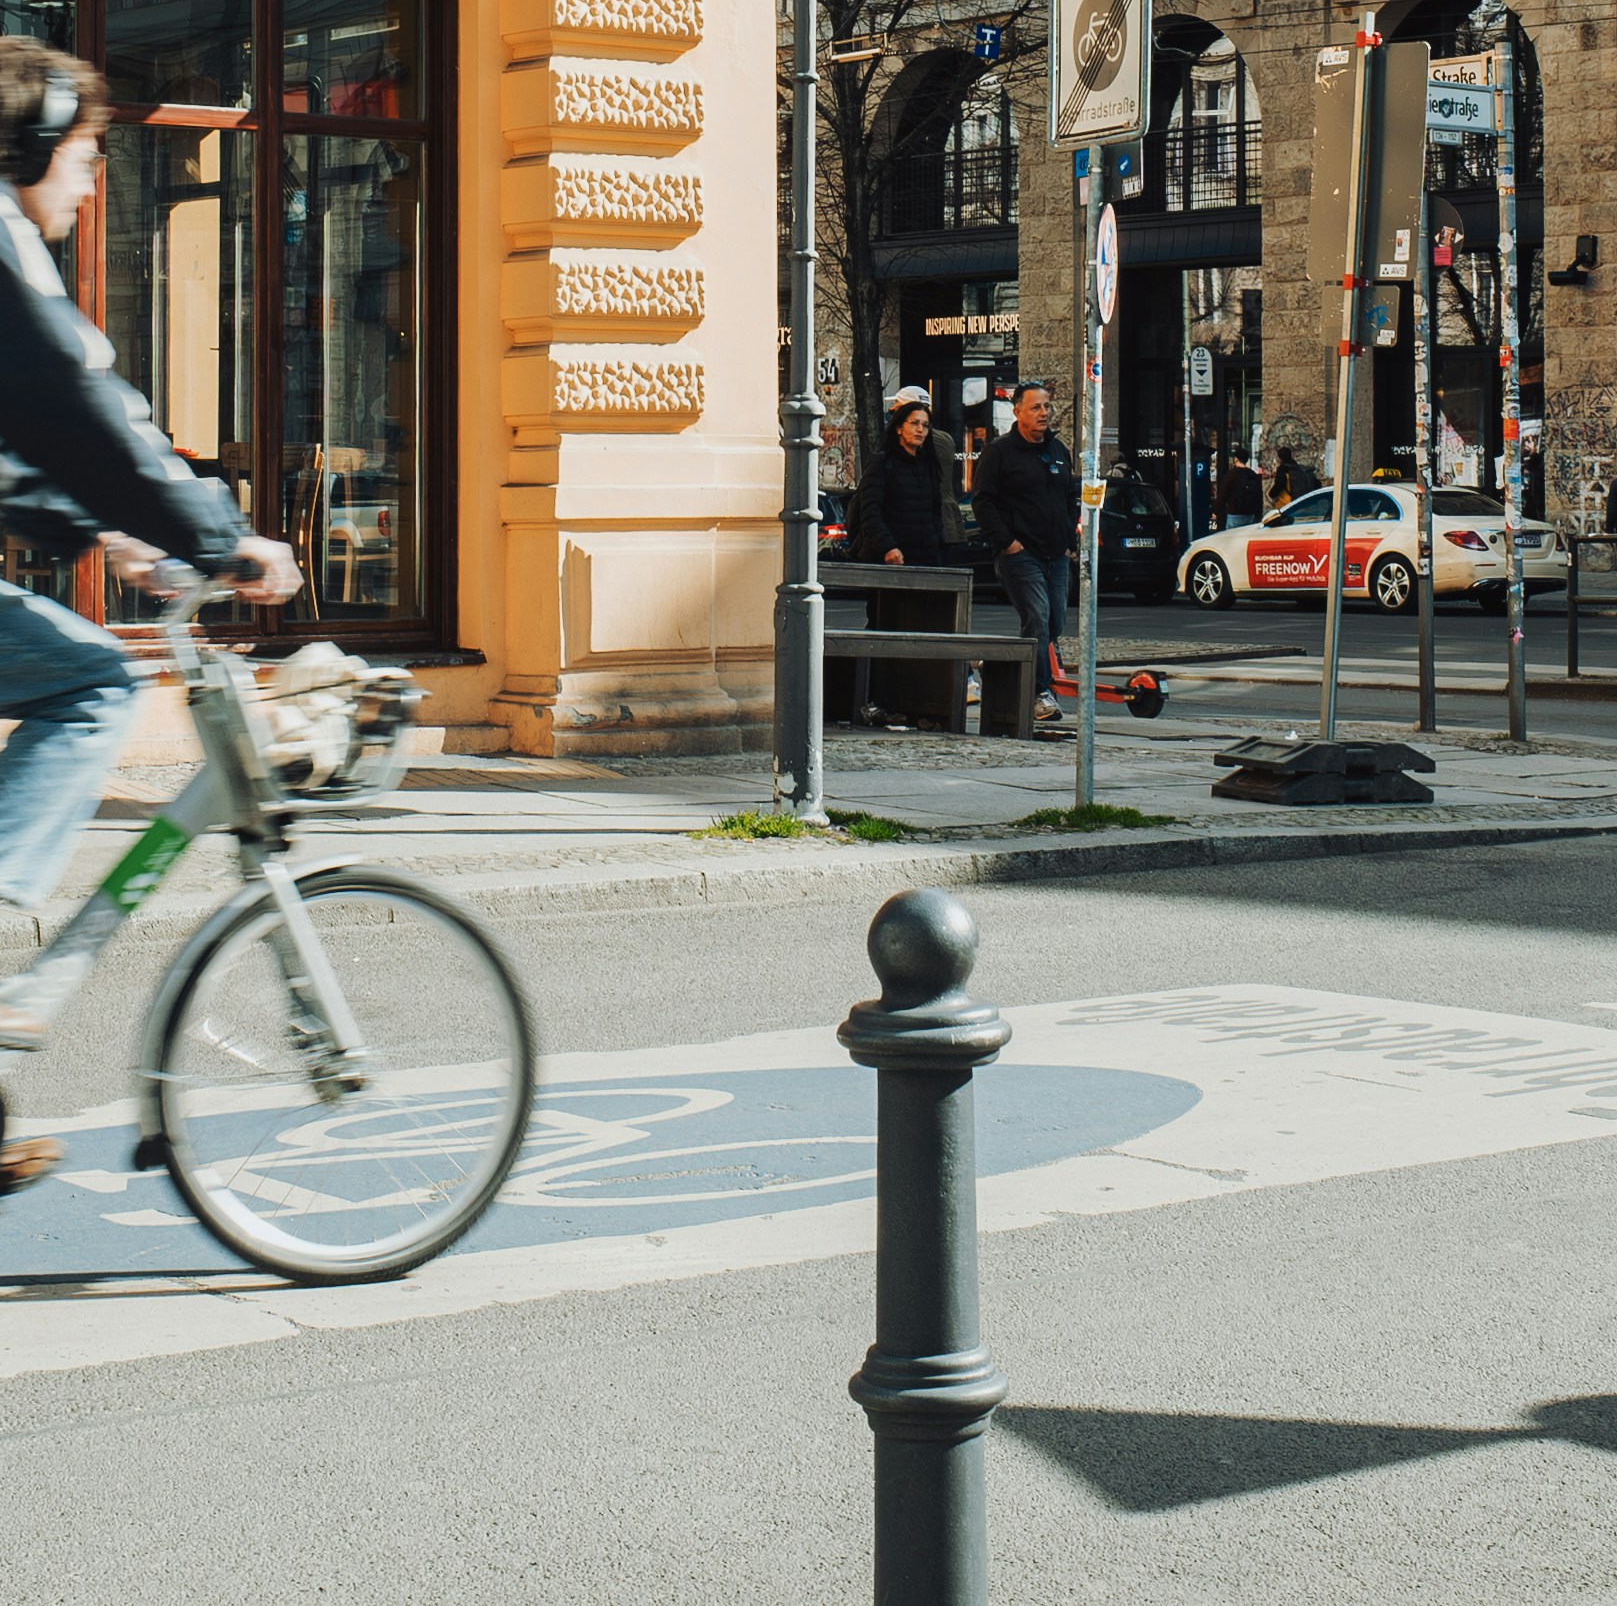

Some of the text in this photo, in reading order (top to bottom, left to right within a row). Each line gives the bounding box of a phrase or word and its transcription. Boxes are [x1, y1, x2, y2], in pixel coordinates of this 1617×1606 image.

[1070, 97, 1136, 123] rradstraße
[1428, 94, 1479, 122] ietraße
[925, 316, 966, 336] INSPIRING
[967, 315, 987, 334] NEW
[817, 357, 837, 383] 54
[1255, 562, 1311, 575] FREENOW
